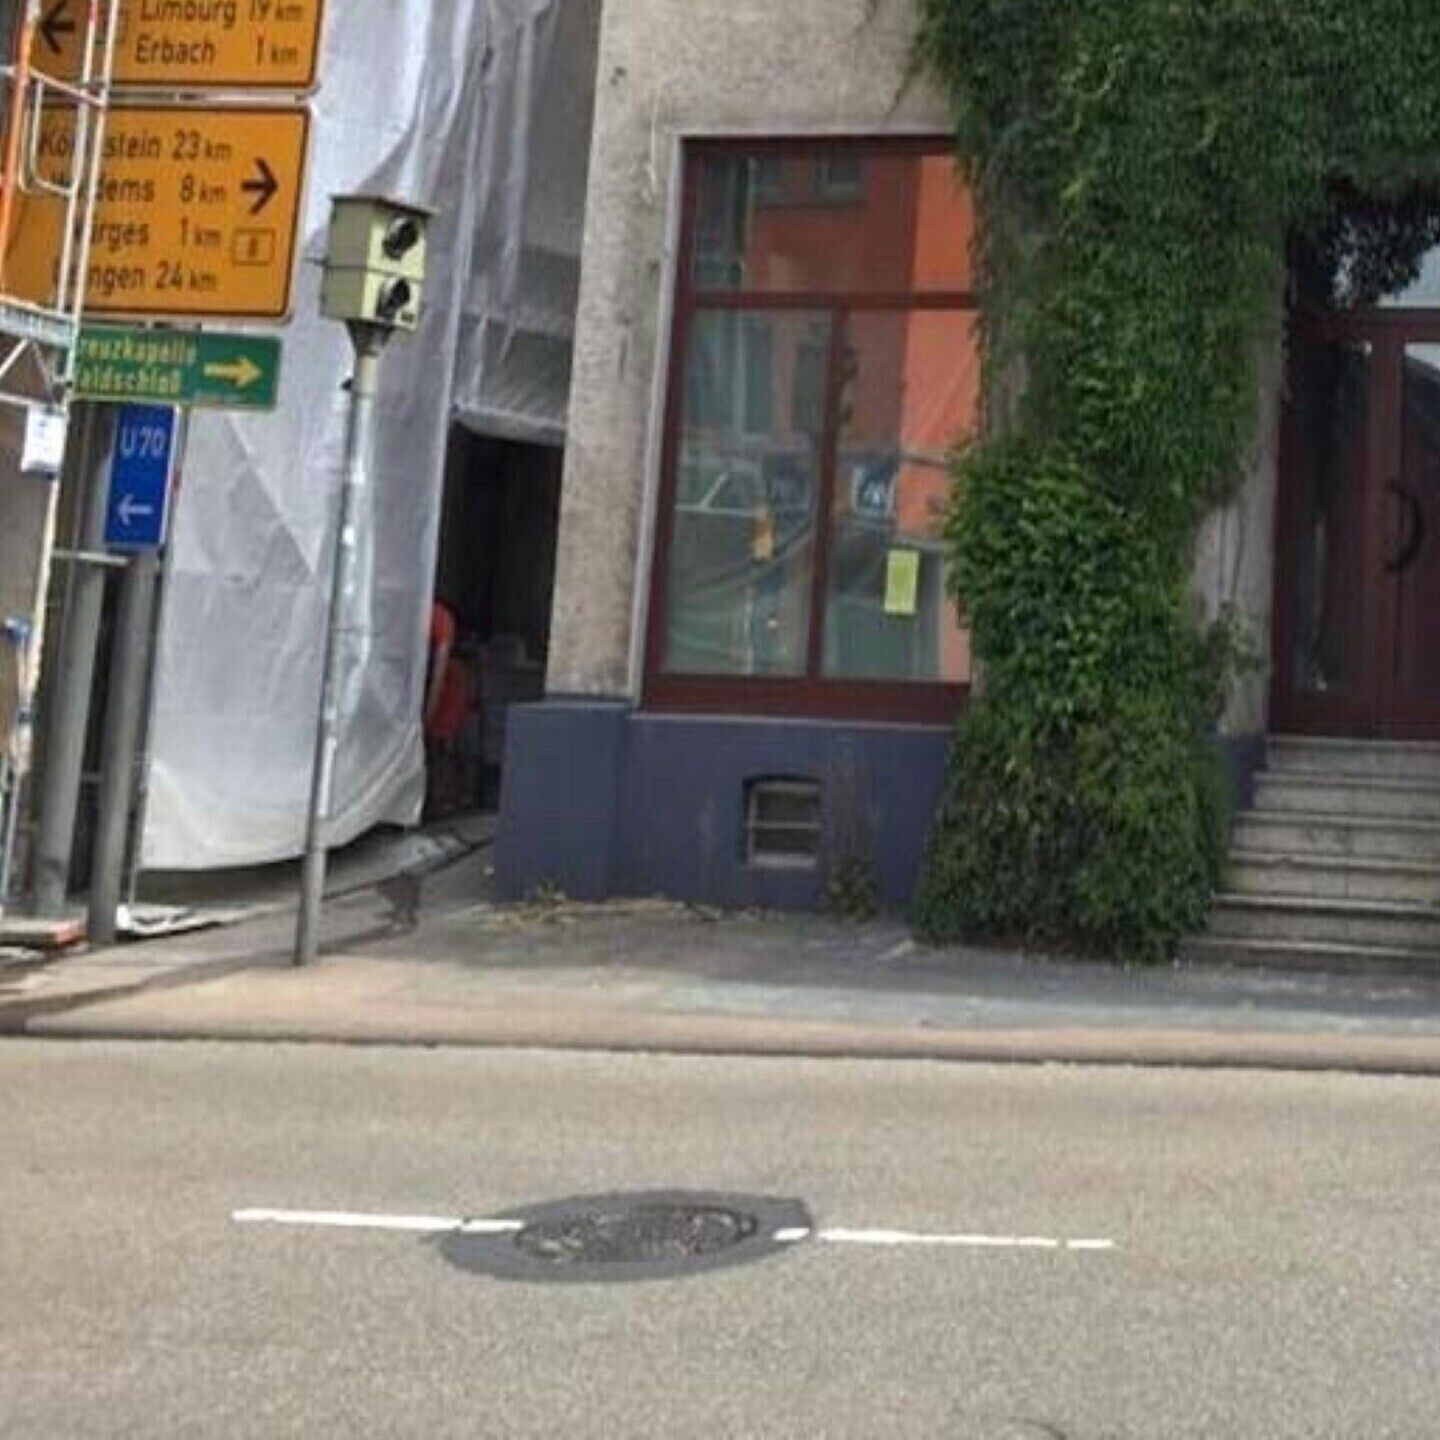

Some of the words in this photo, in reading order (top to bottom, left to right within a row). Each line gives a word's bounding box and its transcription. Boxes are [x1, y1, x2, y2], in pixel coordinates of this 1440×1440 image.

[274, 2, 303, 24] km
[134, 34, 216, 64] Erbach
[256, 34, 266, 66] 1
[270, 44, 298, 64] km
[172, 128, 202, 161] 23
[205, 138, 234, 160] km
[179, 173, 195, 203] 8
[198, 182, 227, 204] km
[181, 215, 190, 247] 1
[193, 225, 222, 247] km
[155, 260, 183, 291] 24
[188, 268, 218, 292] km
